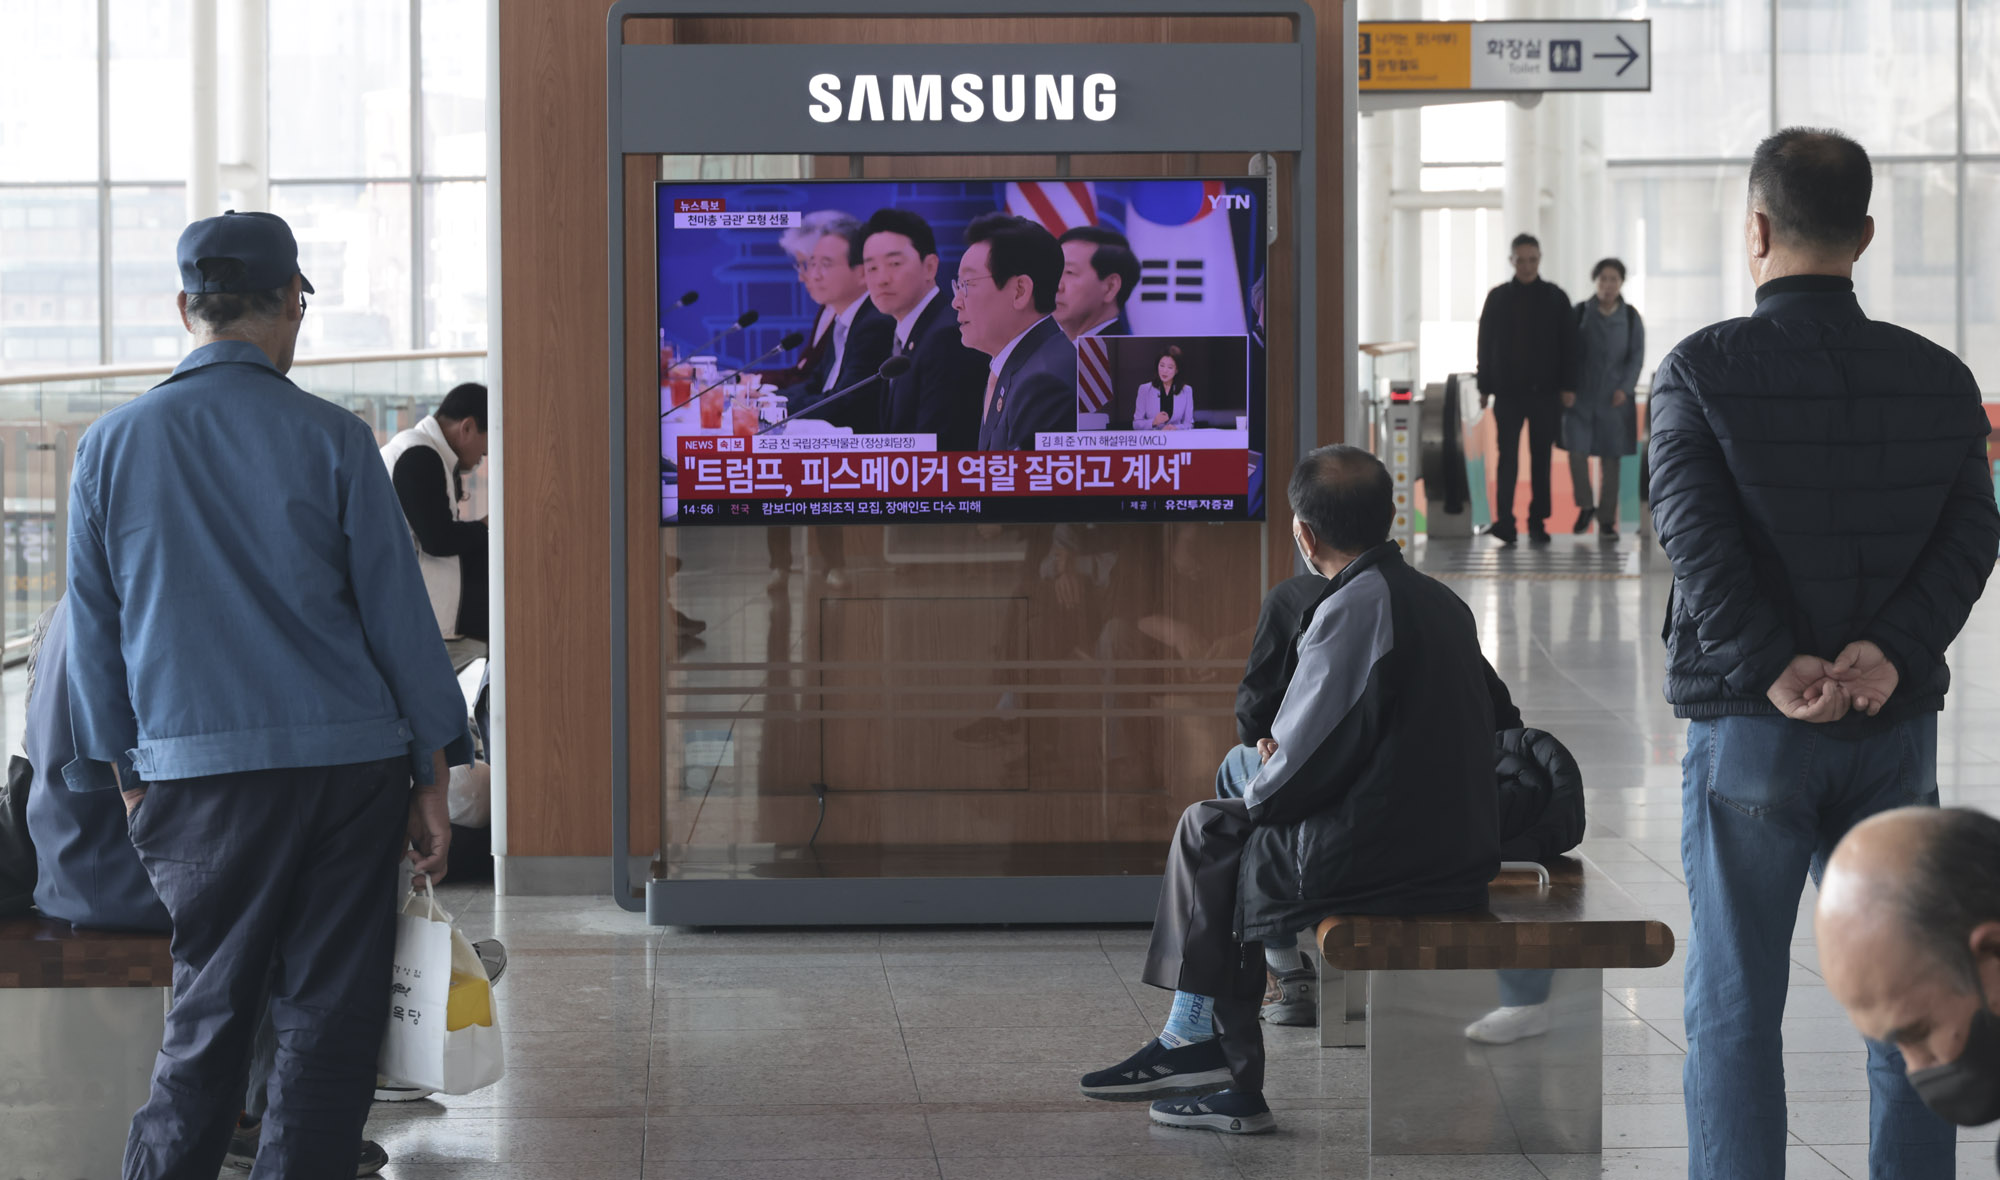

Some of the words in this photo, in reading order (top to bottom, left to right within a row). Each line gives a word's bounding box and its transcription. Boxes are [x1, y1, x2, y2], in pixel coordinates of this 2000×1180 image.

[1487, 39, 1541, 60] 화장실
[1509, 63, 1540, 74] Toilet
[808, 73, 1117, 123] SAMSUNG
[680, 201, 720, 211] 뉴스특보
[1207, 194, 1250, 209] YTN
[688, 215, 717, 226] 천마총
[719, 214, 745, 226] '금관'
[747, 214, 766, 226] 모형
[769, 213, 789, 225] 선물
[685, 440, 714, 450] NEWS
[758, 438, 778, 450] 조금
[780, 438, 790, 450] 전
[792, 437, 859, 449] 국립경주박물관
[861, 436, 916, 449] (정상회담장)
[1077, 436, 1097, 446] YTN
[1099, 435, 1137, 447] 해설위원
[1139, 434, 1167, 447] (MCL)
[684, 456, 793, 497] "트럼프,
[800, 456, 949, 493] 피스메이커
[957, 455, 1018, 492] 역할
[1024, 454, 1115, 492] 잘하고
[1121, 451, 1192, 490] 계셔"
[683, 504, 714, 514] 14:56
[730, 504, 750, 514] 전국
[761, 502, 807, 515] 캄보디아
[809, 501, 855, 515] 범죄조직
[857, 501, 883, 514] 모집,
[885, 501, 931, 514] 장애인도
[933, 501, 956, 513] 다수
[958, 500, 981, 513] 피해
[1130, 501, 1148, 510] 제공
[1165, 499, 1234, 510] 유진투자증권
[393, 1006, 421, 1026] 옥당
